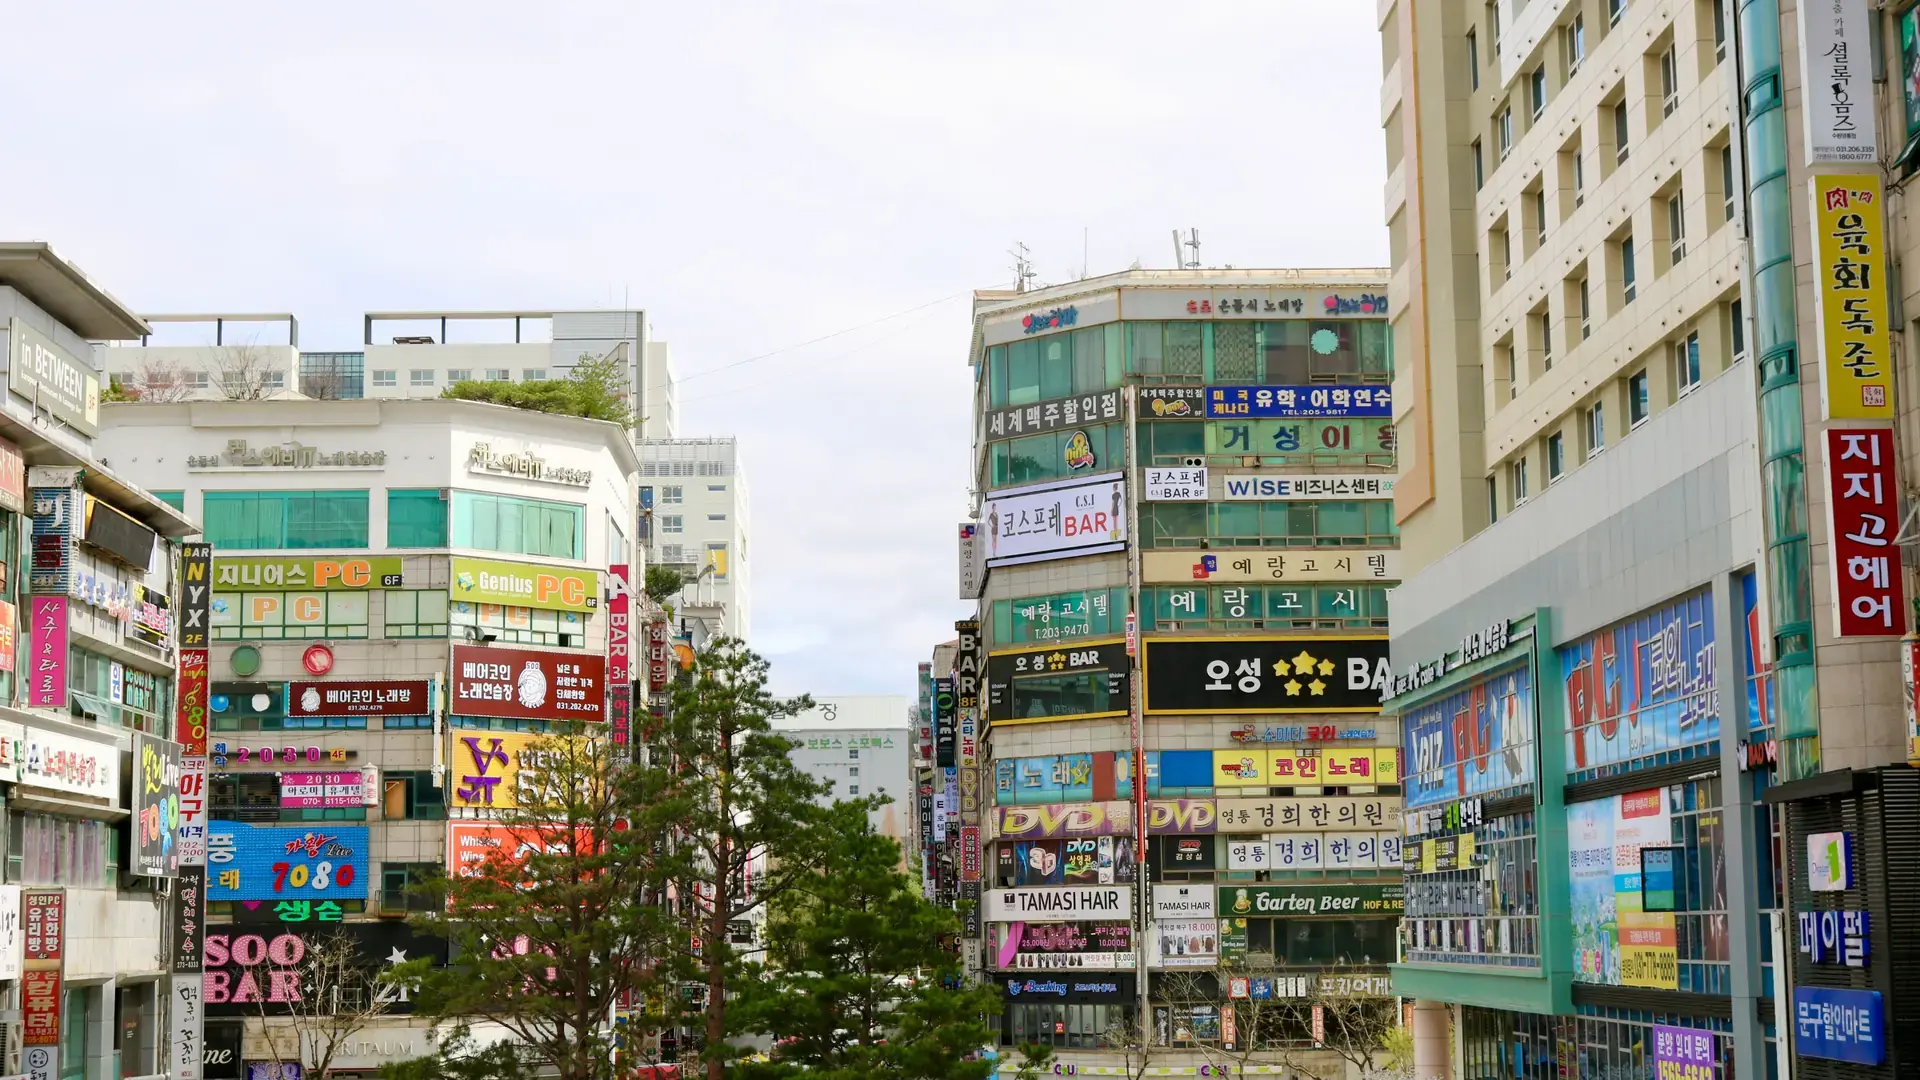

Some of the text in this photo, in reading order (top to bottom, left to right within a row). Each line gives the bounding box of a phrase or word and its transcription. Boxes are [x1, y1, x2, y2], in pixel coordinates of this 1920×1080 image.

[1834, 17, 1844, 38] 카페
[1838, 153, 1873, 161] 1800.6777
[1263, 298, 1304, 315] 노래방
[21, 333, 84, 402] in BETWEEN
[1139, 388, 1204, 399] 세계맥주할인점
[1213, 389, 1249, 401] 미국
[989, 392, 1117, 436] 세계맥주할인점
[1213, 402, 1250, 414] 캐나다
[318, 449, 388, 466] 노래연습장
[545, 465, 592, 484] 노래연습장
[1149, 469, 1205, 488] 코스프레
[1164, 488, 1190, 498] BAR
[1193, 489, 1205, 497] 8F
[1294, 478, 1379, 495] 비즈니스센터
[1075, 493, 1096, 509] C.S.I
[1002, 501, 1062, 538] 코스프레
[1064, 511, 1108, 537] BAR
[1839, 433, 1894, 628] 지지고헤어
[184, 547, 210, 558] BAR
[217, 560, 371, 588] 지니어스 PC
[1232, 553, 1386, 579] 예랑고시텔
[384, 575, 400, 586] 6F
[479, 571, 585, 607] Genius PC
[184, 562, 205, 628] NYX
[586, 599, 597, 607] 6F
[252, 596, 322, 623] PC
[184, 633, 204, 644] 2F
[609, 613, 628, 658] BAR
[960, 634, 976, 694] BAR
[1015, 650, 1100, 672] 오성 BAR
[462, 662, 512, 682] 베어코인
[612, 666, 627, 680] 3F
[1108, 672, 1126, 680] Whiskey
[1205, 657, 1262, 693] 오성
[458, 681, 514, 702] 노래연습장
[580, 677, 593, 689] 가격
[41, 694, 54, 704] 4F
[326, 689, 411, 704] 베어코인 노래방
[961, 697, 977, 707] 8F
[556, 701, 599, 712] 031.202.4279
[807, 737, 843, 750] 보보스
[1261, 726, 1303, 743] 쇼미더
[1307, 725, 1337, 742] 코인
[1338, 728, 1377, 739] 노래연습장
[214, 742, 228, 769] 헤라
[236, 746, 321, 764] 2030
[331, 749, 345, 760] 4F
[160, 753, 179, 788] Live
[1023, 760, 1071, 788] 노래
[1274, 757, 1370, 778] 코인 노래
[1378, 761, 1394, 772] 5F
[306, 774, 341, 784] 2030
[179, 773, 204, 822] 야구
[287, 785, 319, 796] 아로마
[963, 769, 979, 813] DVD
[140, 793, 179, 848] 7080
[1001, 804, 1104, 835] DVD
[1150, 801, 1216, 832] DVD
[1221, 801, 1384, 828] 영통 경희한의원
[179, 826, 204, 839] 사격
[459, 835, 502, 848] Whiskey
[1066, 840, 1096, 853] DVD
[1179, 840, 1201, 848] DVD
[1233, 845, 1266, 864] 영통
[1274, 837, 1401, 865] 경희한의원
[459, 850, 485, 862] Wine
[1068, 854, 1092, 866] 상영관
[1175, 852, 1203, 861] 감상실
[271, 860, 356, 893] 7080
[28, 895, 60, 906] 성인PC
[1018, 890, 1119, 911] TAMASI HAIR
[1157, 901, 1211, 911] TAMASI HAIR
[1255, 891, 1360, 914] Garten Beer
[1362, 900, 1382, 910] HOF
[1383, 900, 1391, 910] &
[28, 907, 43, 952] 유리방
[45, 907, 60, 952] 전화방
[203, 933, 305, 967] SOO
[203, 970, 302, 1004] BAR
[27, 980, 56, 1029] 컴퓨터
[1798, 1001, 1873, 1044] 문구할인마트
[333, 1041, 415, 1056] RITAUM
[1657, 1031, 1710, 1062] 분양 임대 문의
